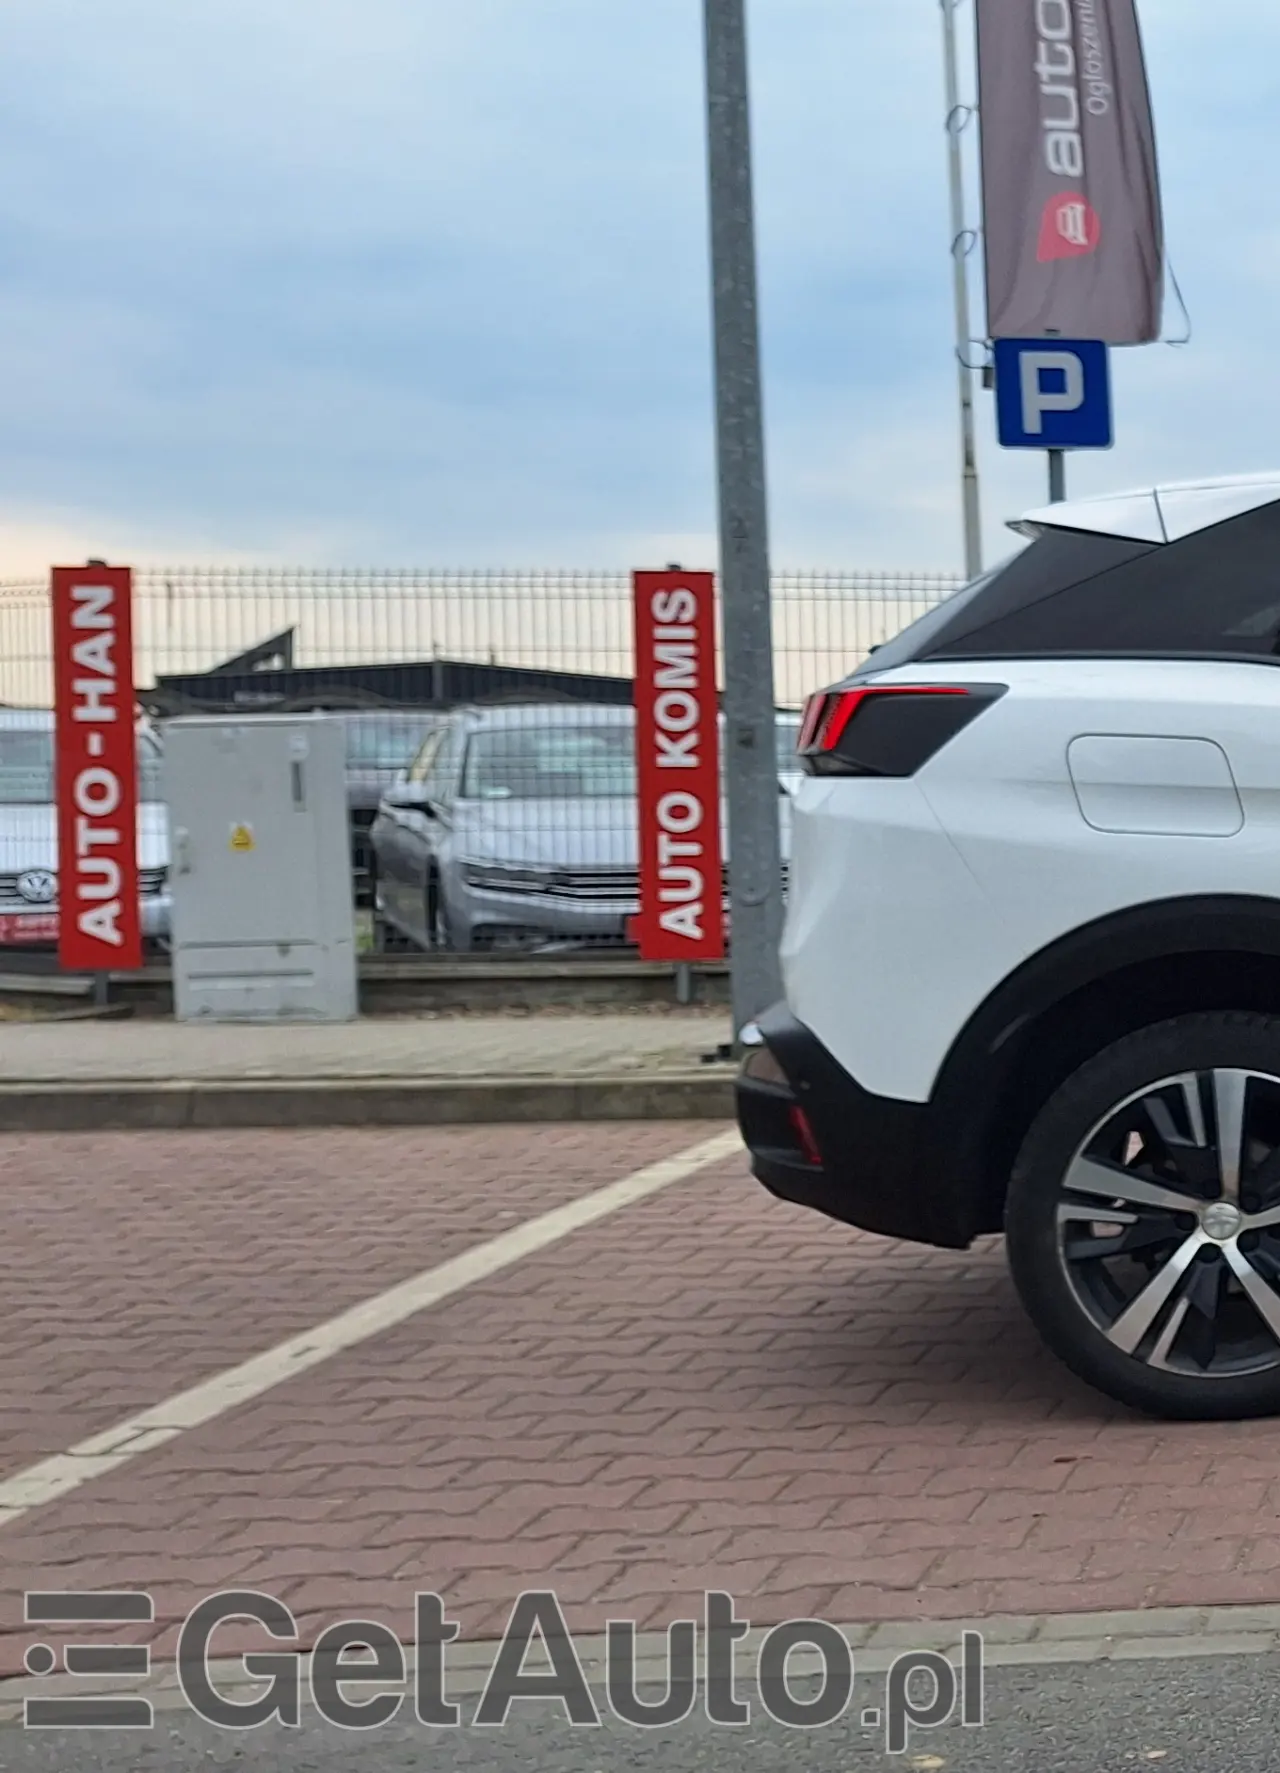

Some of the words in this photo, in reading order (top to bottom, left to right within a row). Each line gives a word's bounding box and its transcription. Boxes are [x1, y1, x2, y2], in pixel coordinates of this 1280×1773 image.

[1019, 350, 1084, 434] P
[651, 588, 700, 768] KOMIS
[656, 791, 705, 941] AUTO
